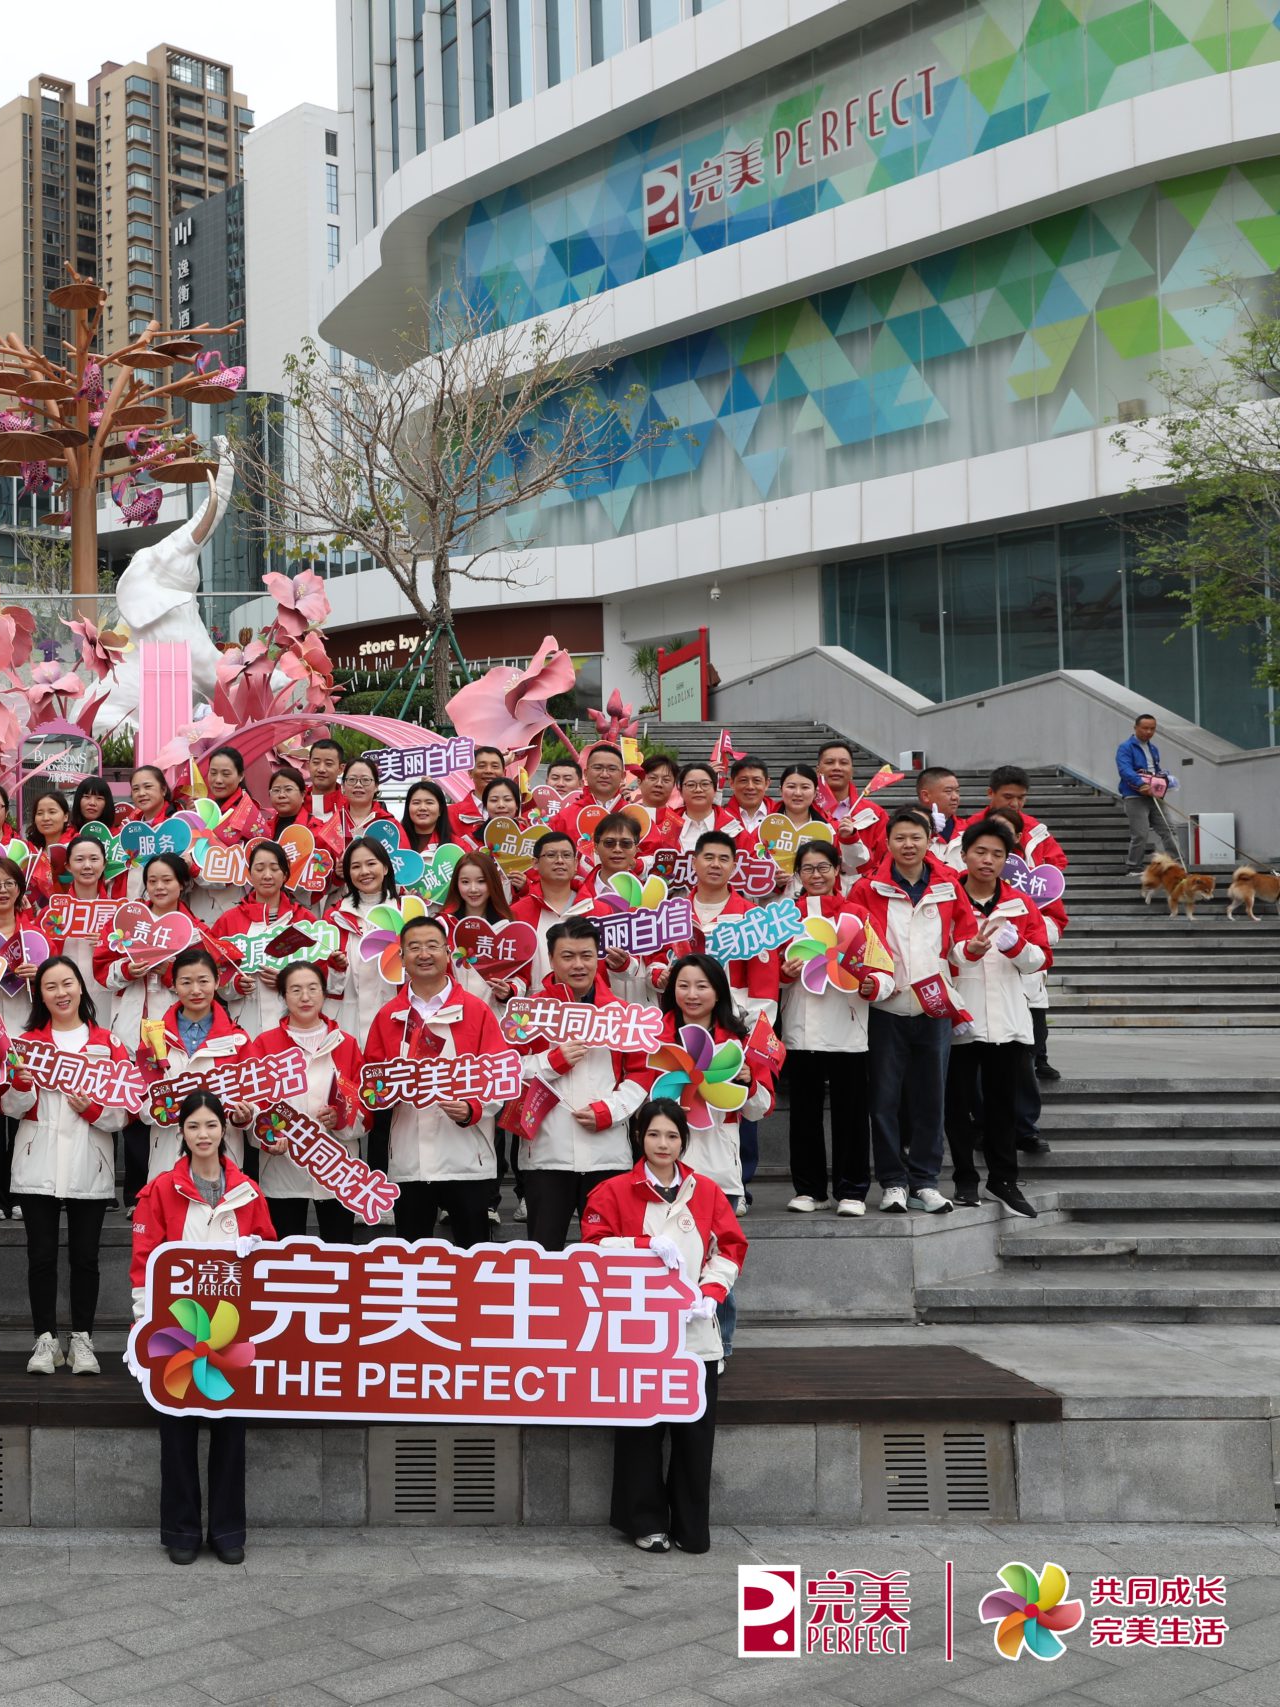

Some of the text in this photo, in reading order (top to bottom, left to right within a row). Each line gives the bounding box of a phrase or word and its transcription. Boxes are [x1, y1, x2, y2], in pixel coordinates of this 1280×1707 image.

[689, 66, 937, 211] 完美 PERFECT
[178, 259, 191, 341] 逸衡酒
[359, 639, 396, 656] store
[399, 634, 419, 652] by
[33, 749, 87, 764] BLSOMS
[378, 740, 471, 782] 美丽自信
[139, 834, 175, 855] 服务
[500, 834, 535, 857] 品质
[422, 861, 455, 891] 诚信
[1011, 869, 1047, 897] 关怀
[131, 920, 173, 949] 责任
[232, 921, 334, 968] 健康力
[475, 936, 517, 961] 责任
[528, 1003, 658, 1052] 共同成长
[24, 1047, 147, 1109] 共同成长
[384, 1053, 517, 1103] 完美生活
[281, 1118, 389, 1220] 共同成长
[197, 1258, 242, 1284] 完美
[197, 1282, 242, 1297] PERFECT
[249, 1253, 680, 1353] 完美生活
[250, 1358, 689, 1405] THE PERFECT LIFE
